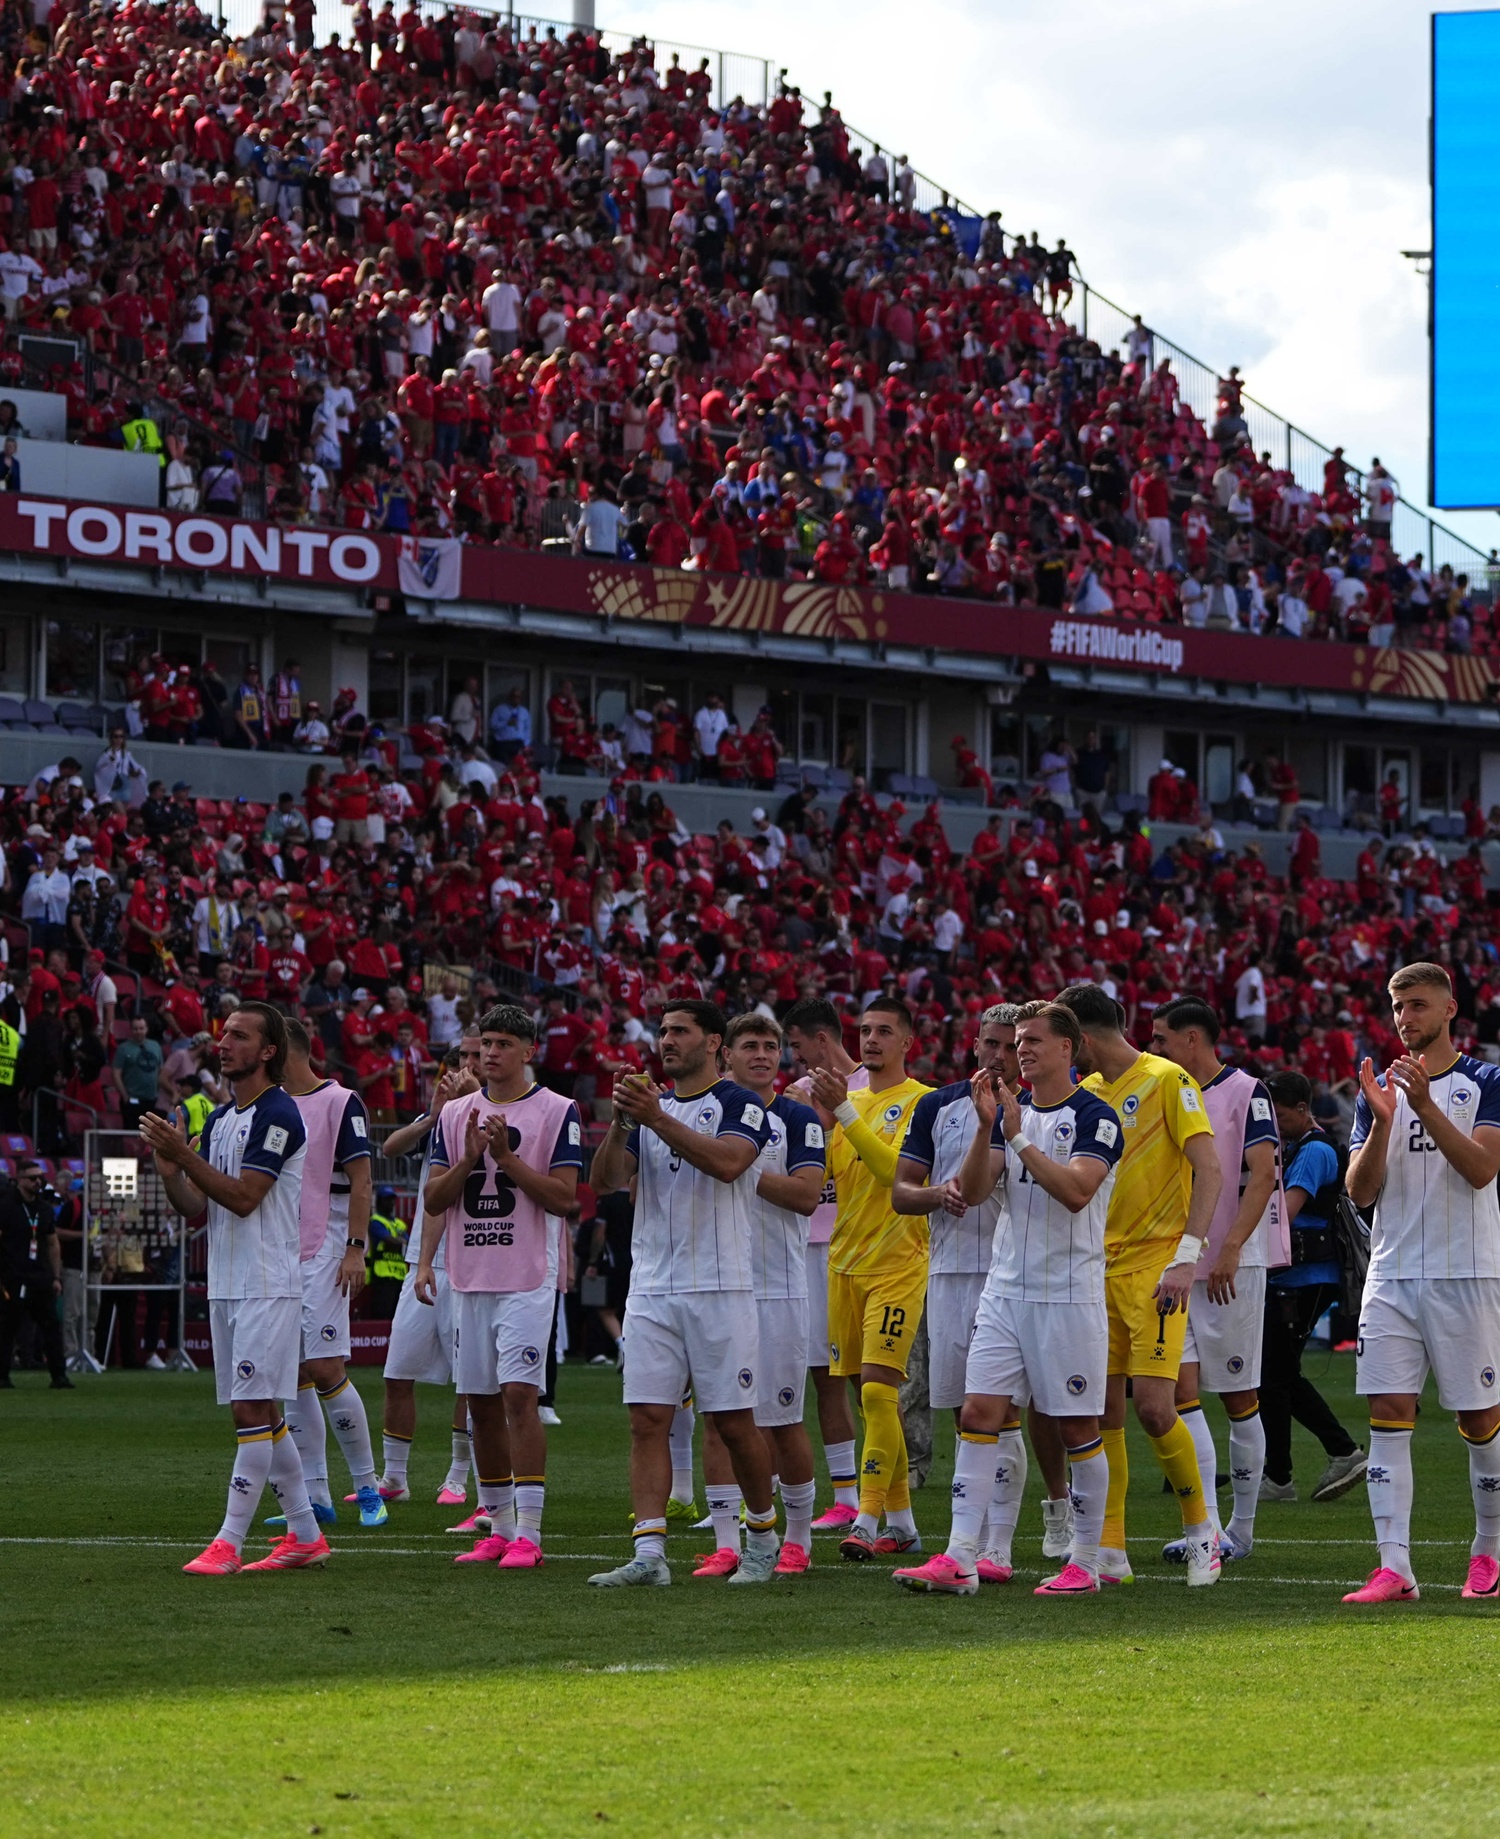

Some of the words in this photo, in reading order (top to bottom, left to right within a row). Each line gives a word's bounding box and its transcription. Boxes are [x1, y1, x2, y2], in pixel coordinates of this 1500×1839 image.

[17, 500, 381, 583] TORONTO
[1051, 620, 1183, 673] #FIFAWorldCup
[477, 1200, 500, 1210] FIFA
[464, 1223, 493, 1231] WORLD
[494, 1222, 514, 1231] CUP
[464, 1233, 514, 1247] 2026
[879, 1306, 906, 1338] 12
[370, 1336, 387, 1347] CUP
